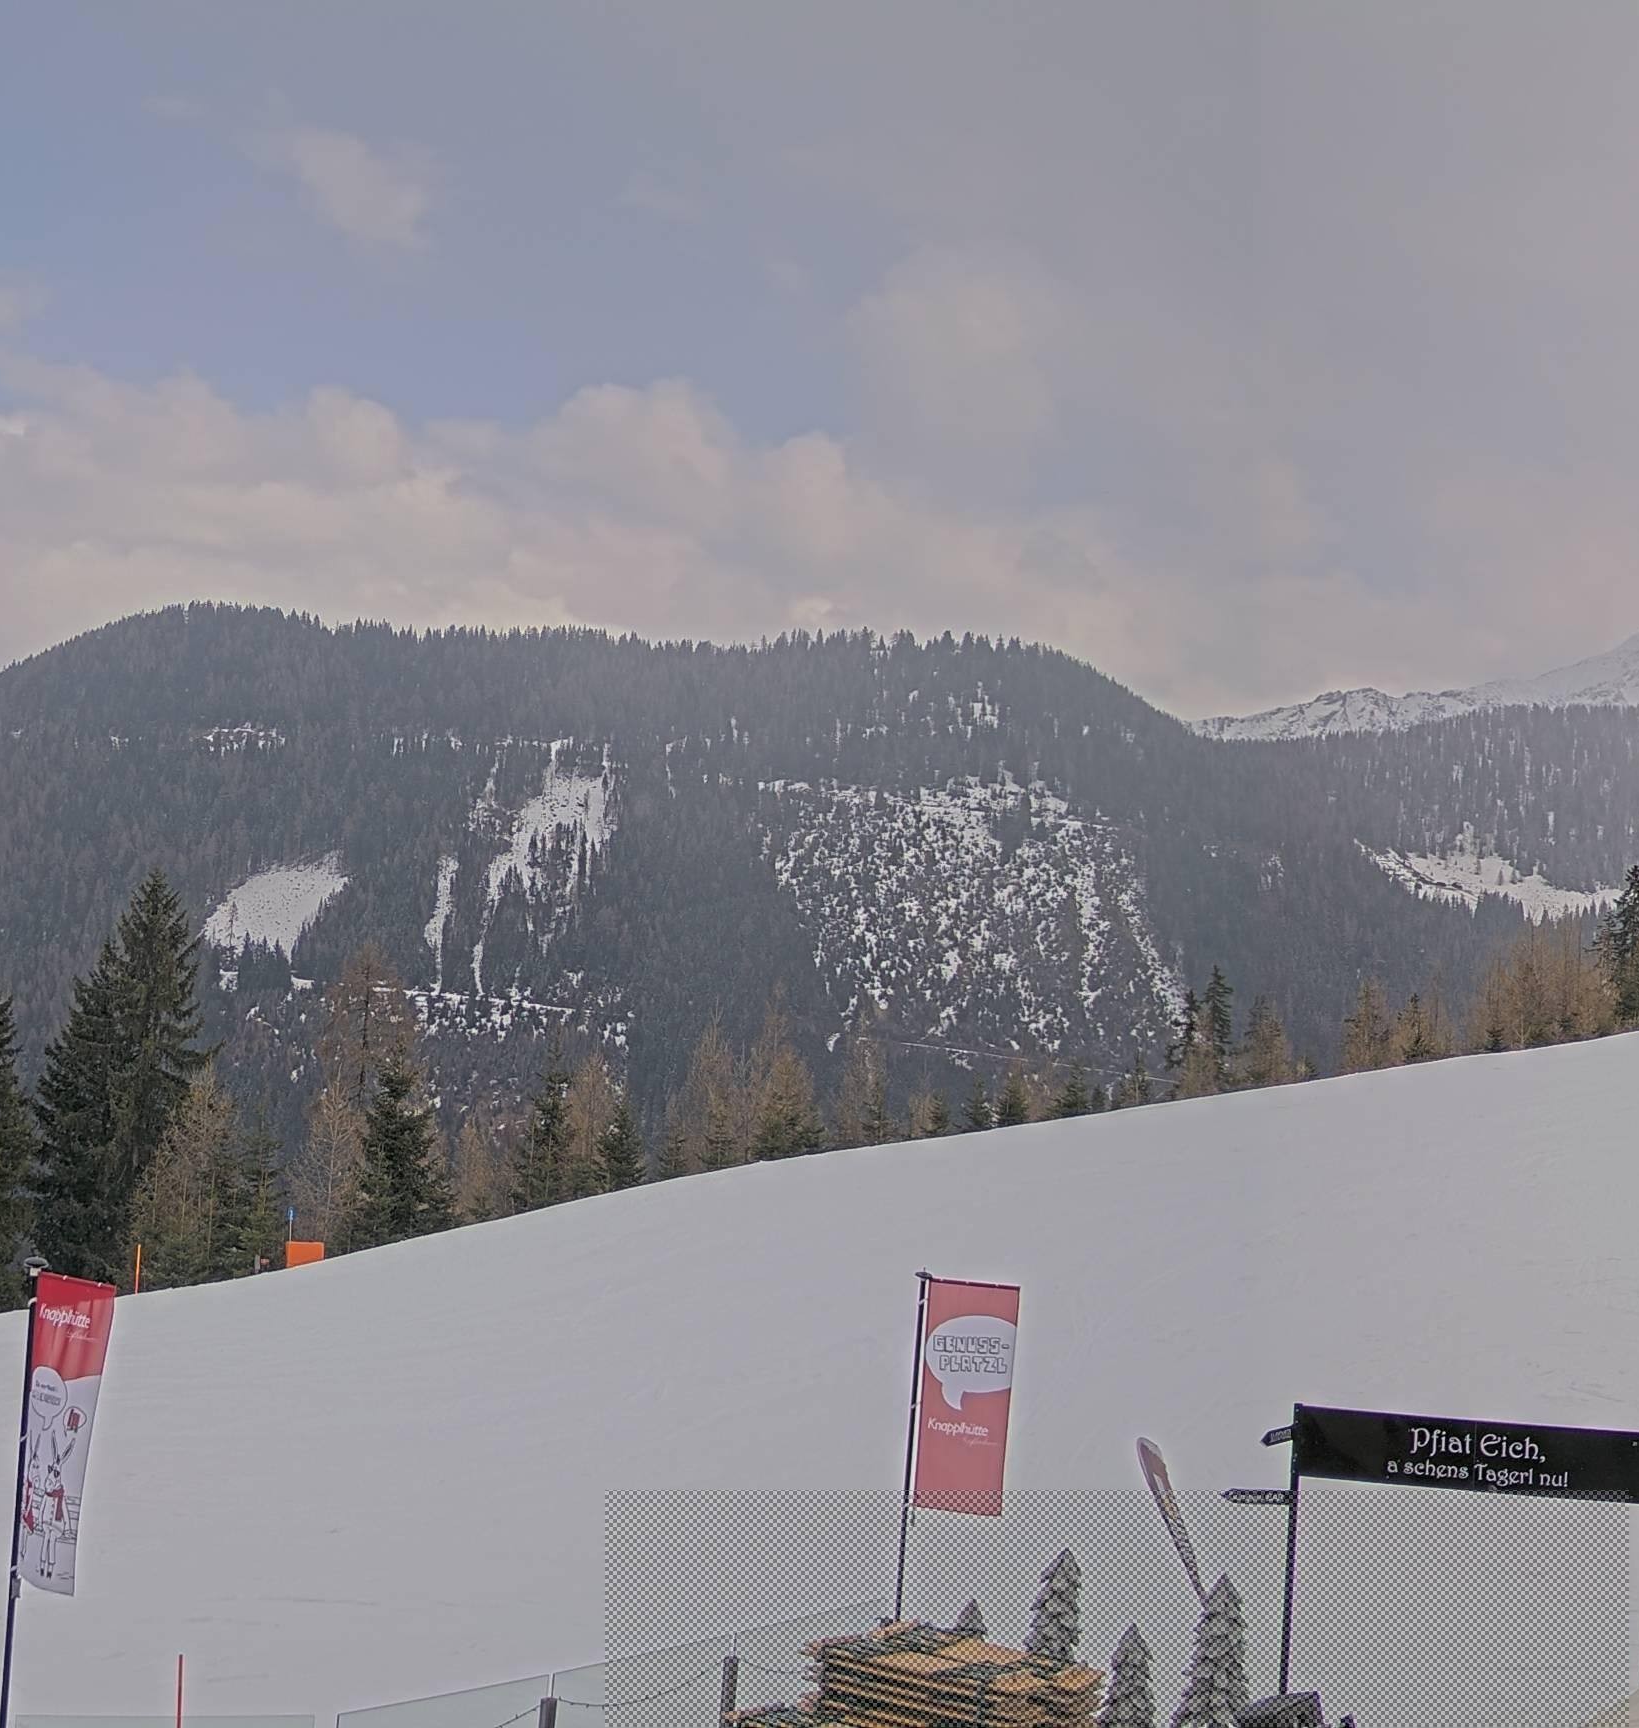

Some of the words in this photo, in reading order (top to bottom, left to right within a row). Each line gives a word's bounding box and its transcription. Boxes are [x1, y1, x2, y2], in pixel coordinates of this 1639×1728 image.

[932, 1335, 1010, 1355] GENUSS-
[940, 1355, 1007, 1374] PLATZL
[927, 1417, 989, 1437] Knapplhütte
[1409, 1427, 1473, 1457] Pfiat
[1479, 1433, 1547, 1464] Eich,
[1474, 1464, 1534, 1487] Tagerl
[1539, 1471, 1569, 1488] nu!
